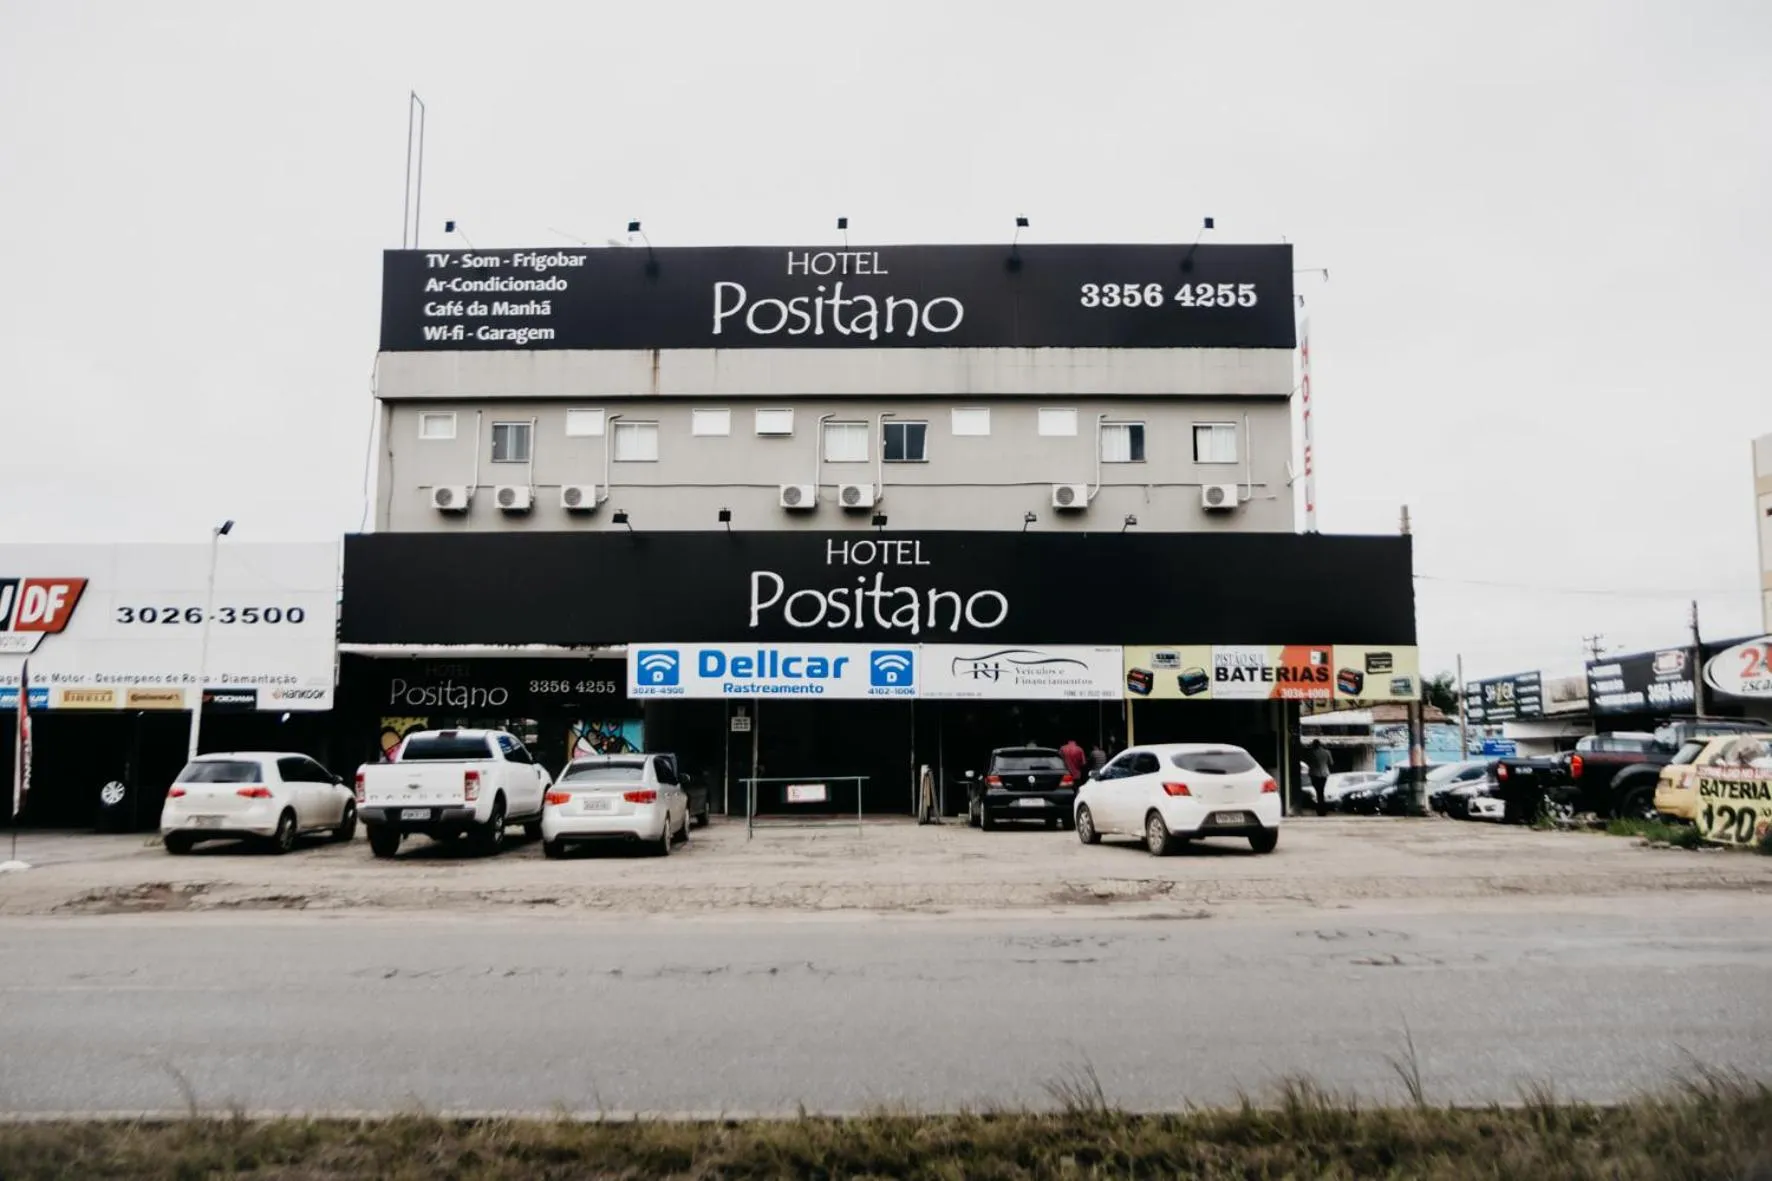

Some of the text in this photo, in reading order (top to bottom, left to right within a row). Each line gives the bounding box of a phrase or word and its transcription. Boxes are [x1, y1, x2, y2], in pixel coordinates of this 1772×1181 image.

[426, 253, 449, 267] TV
[461, 254, 499, 268] Som
[513, 252, 587, 272] Frigobar
[787, 251, 889, 275] HOTEL
[424, 275, 568, 292] Ar-Condicionado
[1080, 283, 1257, 308] 3356 4255
[424, 300, 551, 317] Café da Manhã
[712, 281, 964, 341] Positano
[424, 325, 464, 341] Wi-fi
[476, 325, 555, 345] Garagem
[826, 538, 931, 565] HOTEL
[749, 570, 1009, 636] Positano
[116, 606, 306, 625] 3026-3500
[698, 649, 850, 679] Dellcar
[973, 662, 1000, 683] RJ
[51, 673, 84, 683] Motor
[165, 674, 178, 683] de
[182, 673, 210, 683] Roa
[221, 673, 297, 685] Diamantação
[1215, 666, 1330, 683] BATERIAS
[390, 678, 509, 710] Positano
[529, 680, 616, 694] 3356 4255
[723, 682, 824, 694] Rastreamento
